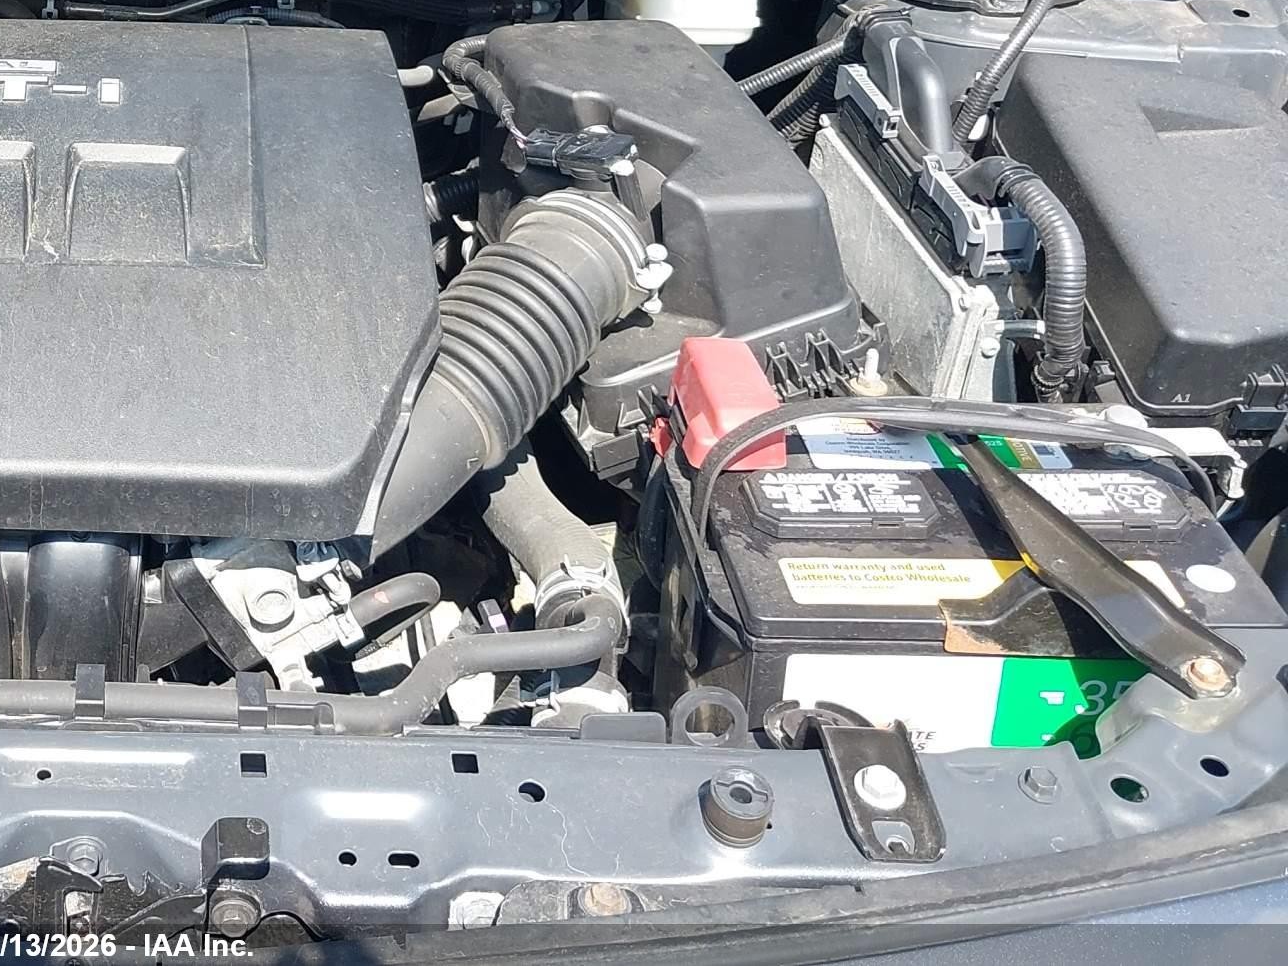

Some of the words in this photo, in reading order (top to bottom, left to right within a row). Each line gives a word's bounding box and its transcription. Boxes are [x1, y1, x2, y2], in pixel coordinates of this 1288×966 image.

[1170, 393, 1191, 403] A1
[787, 562, 830, 571] Return
[832, 562, 887, 573] warranty
[890, 562, 912, 571] and
[915, 562, 946, 572] used
[792, 572, 847, 582] batteries
[849, 573, 862, 582] to
[864, 573, 903, 582] Costco
[905, 573, 972, 583] Wholesale
